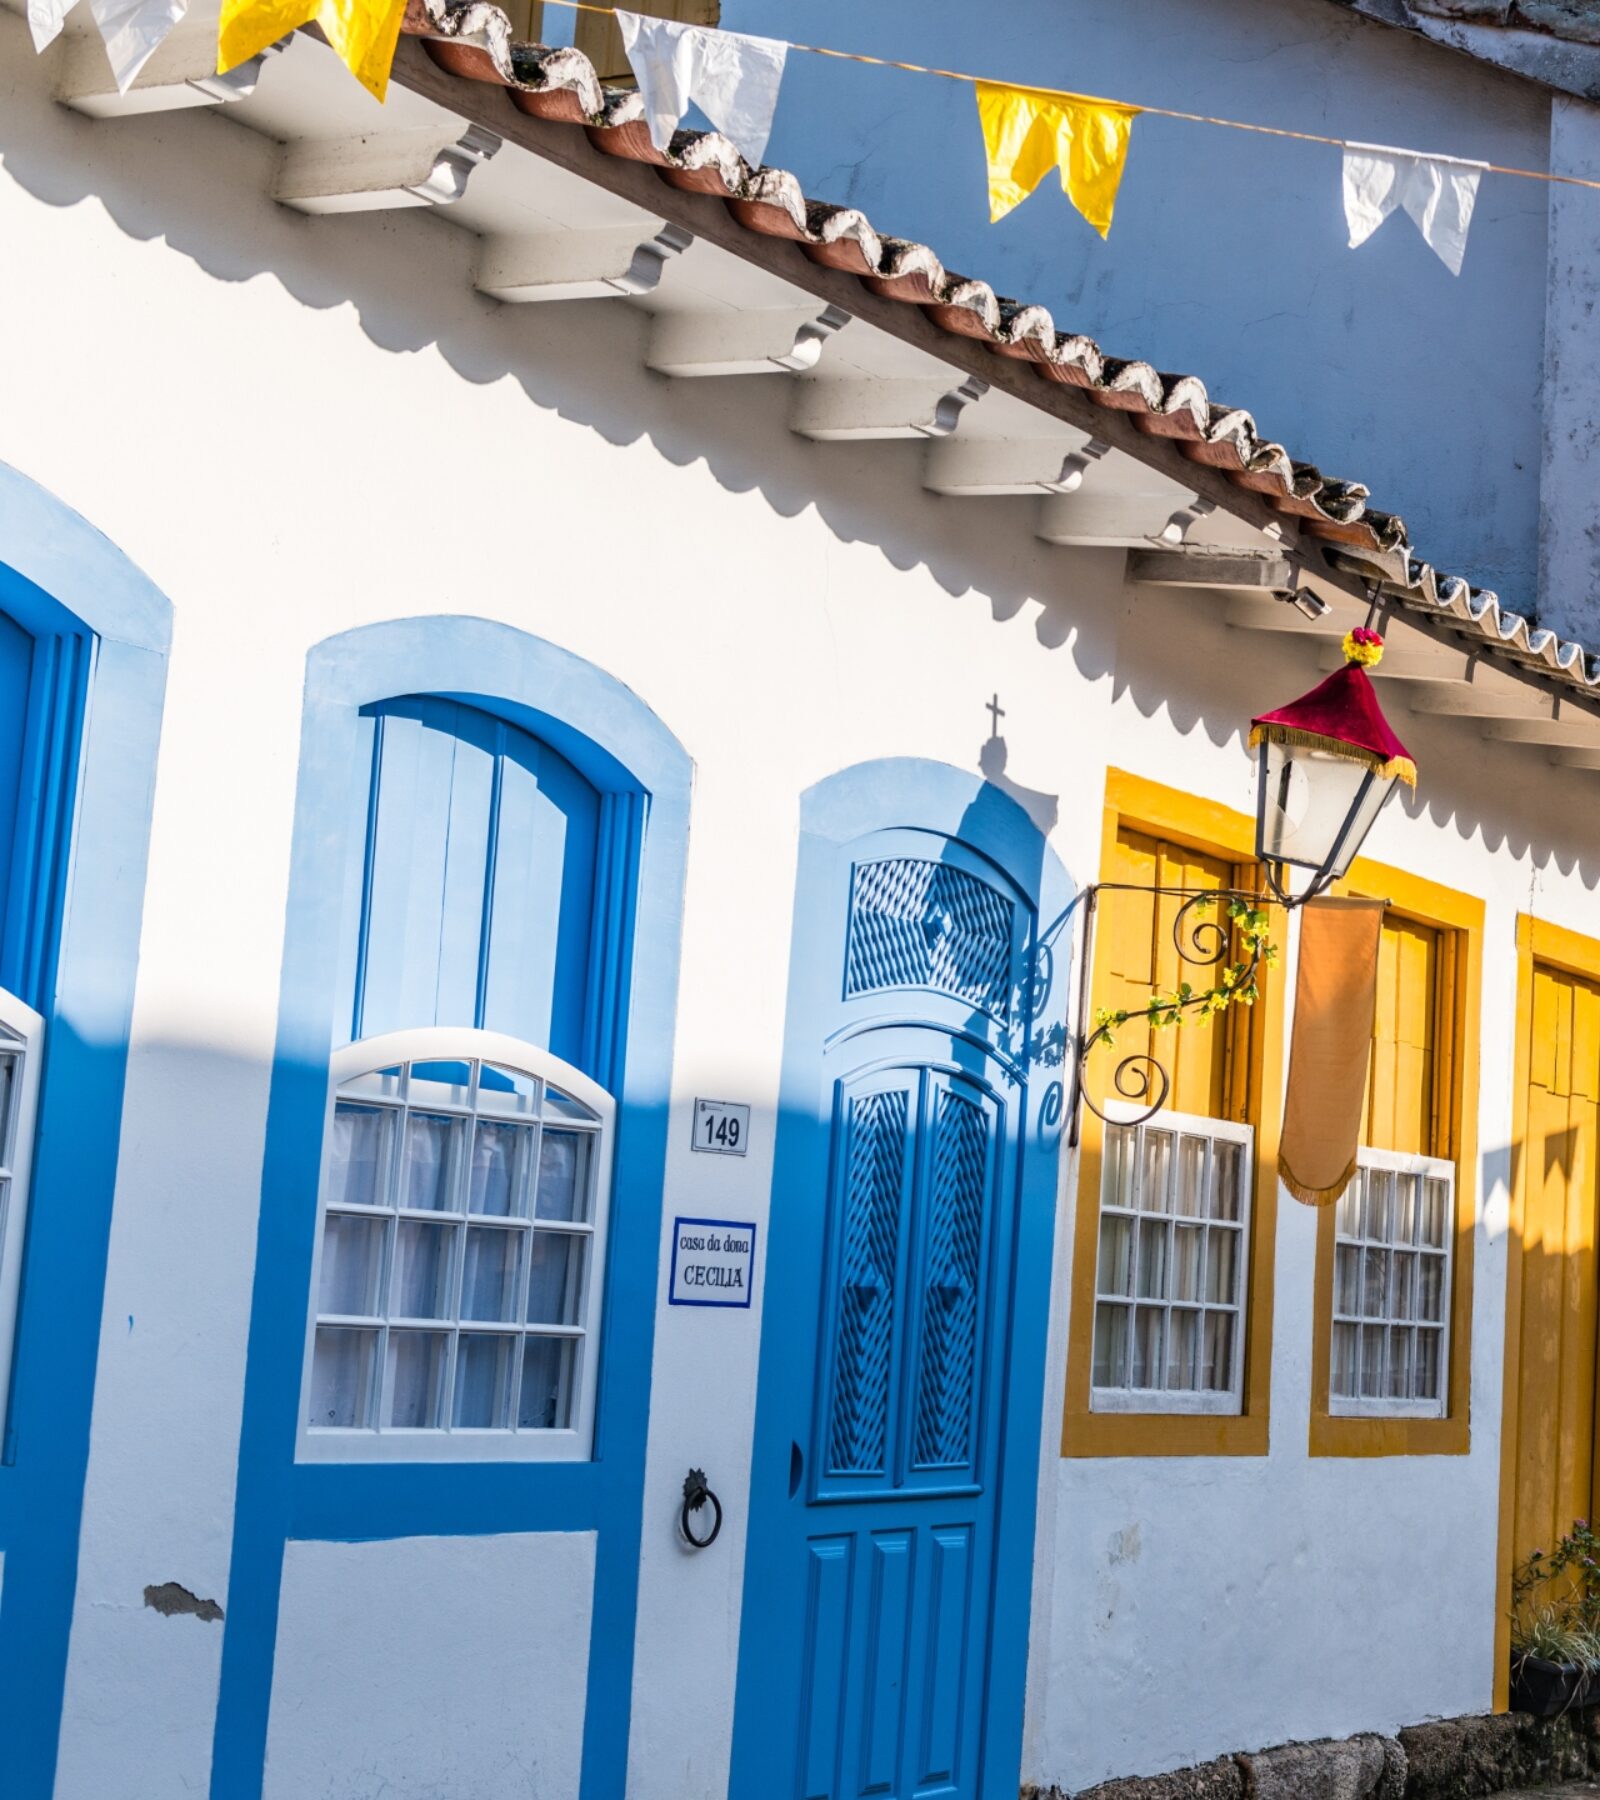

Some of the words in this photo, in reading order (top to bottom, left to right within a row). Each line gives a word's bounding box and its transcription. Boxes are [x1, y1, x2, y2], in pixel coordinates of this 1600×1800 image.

[705, 1115, 740, 1147] 149
[680, 1236, 705, 1251] casa
[707, 1234, 721, 1252] da
[723, 1234, 749, 1253] dona
[684, 1265, 744, 1288] CECILIA
